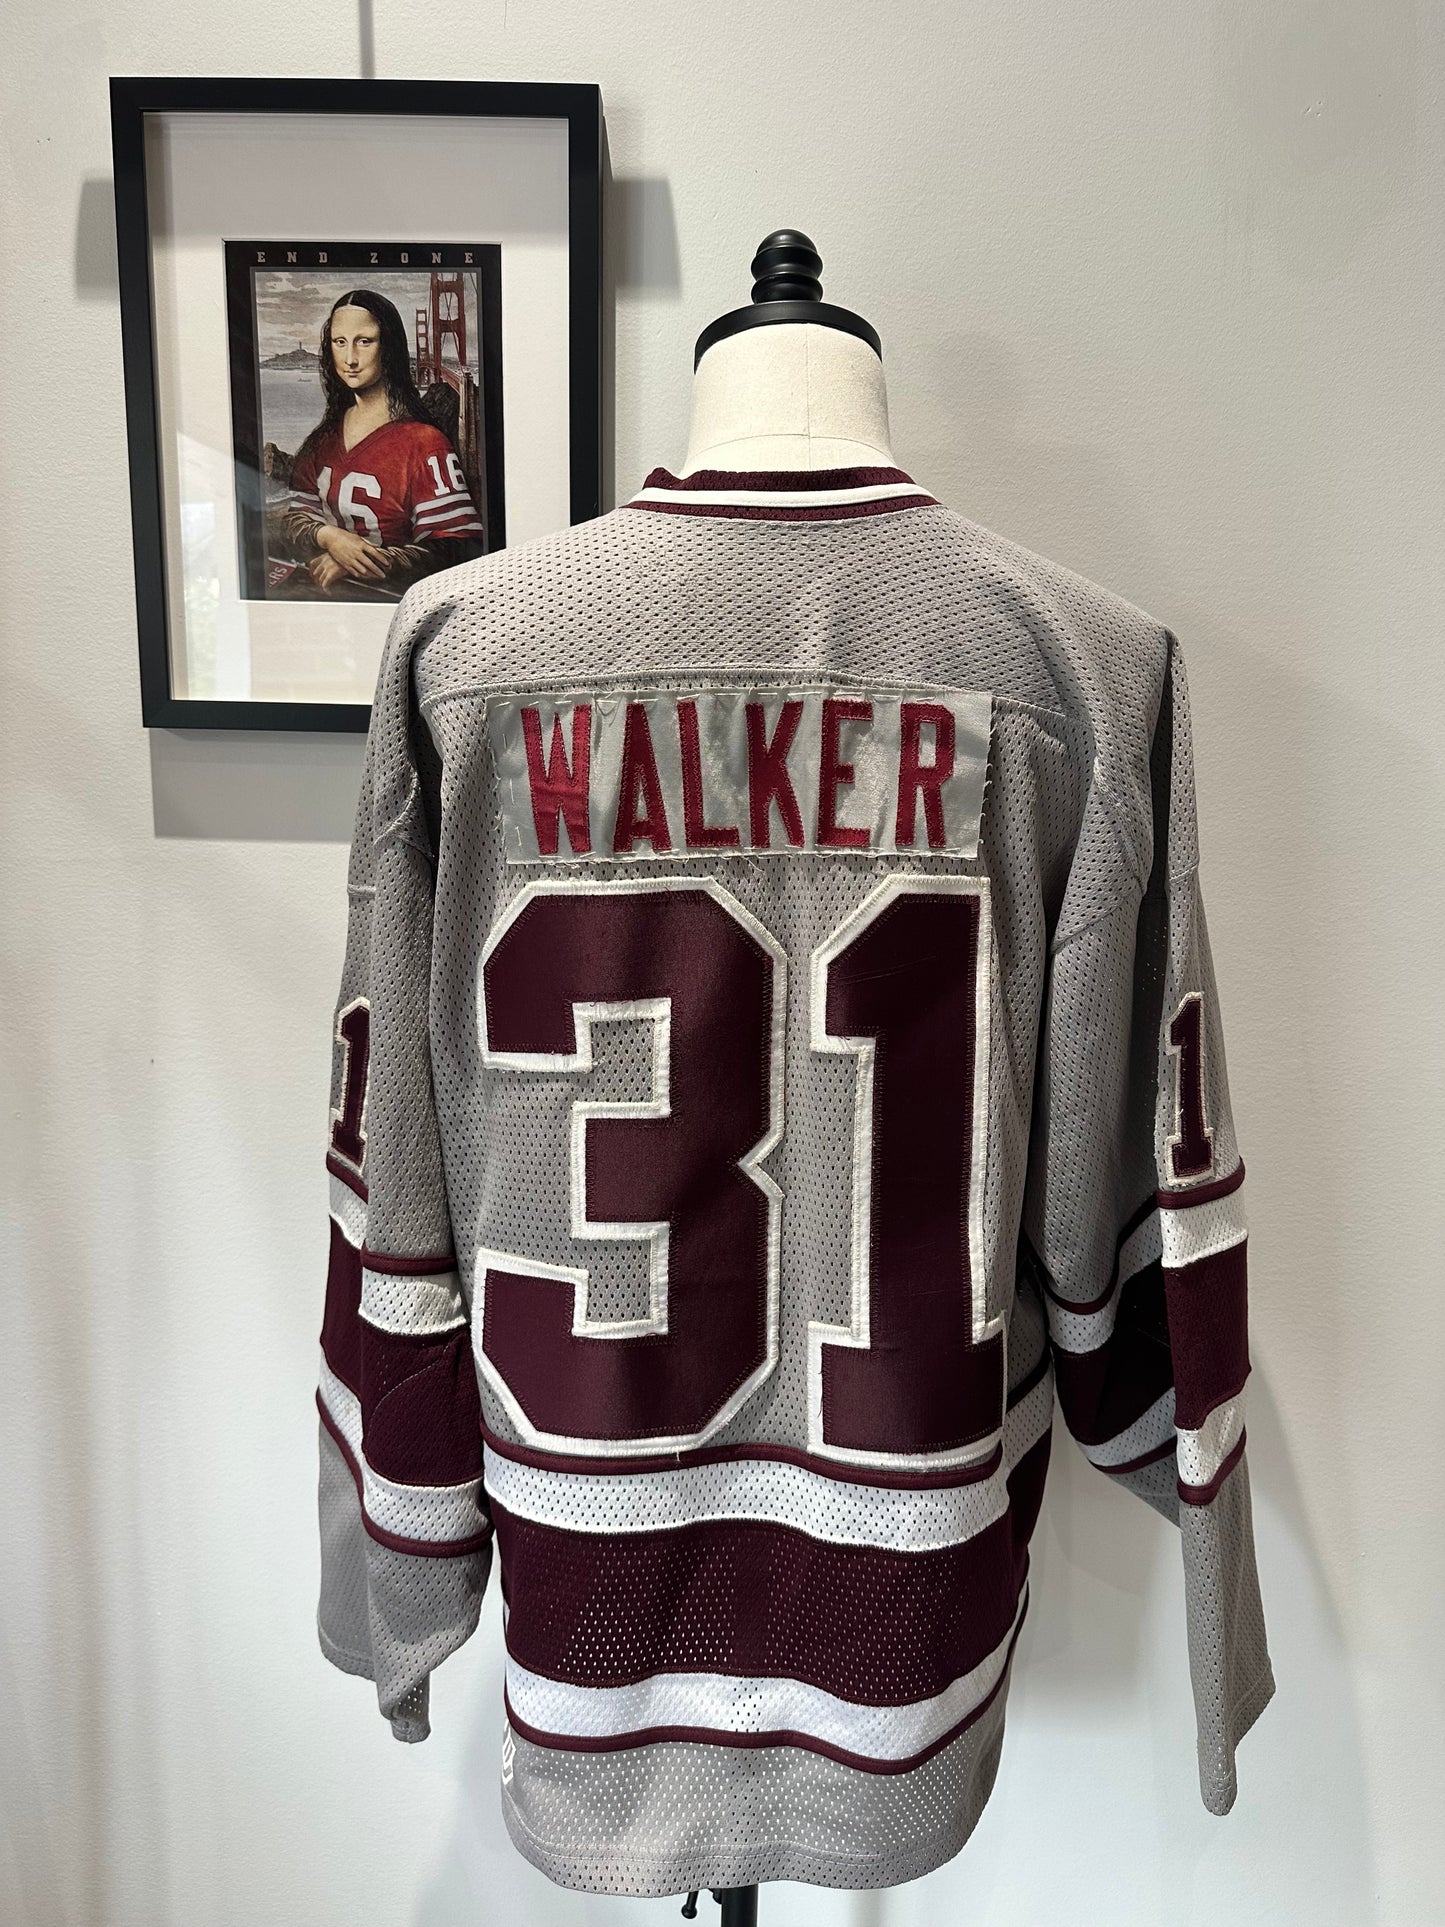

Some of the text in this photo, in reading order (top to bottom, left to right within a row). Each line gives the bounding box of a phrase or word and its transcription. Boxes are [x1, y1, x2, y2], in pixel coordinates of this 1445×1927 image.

[257, 251, 473, 264] END ZONE
[427, 453, 468, 496] 16
[520, 699, 956, 856] WALKER
[329, 997, 371, 1176] 1
[1164, 991, 1215, 1186] 1
[474, 876, 1007, 1467] 31
